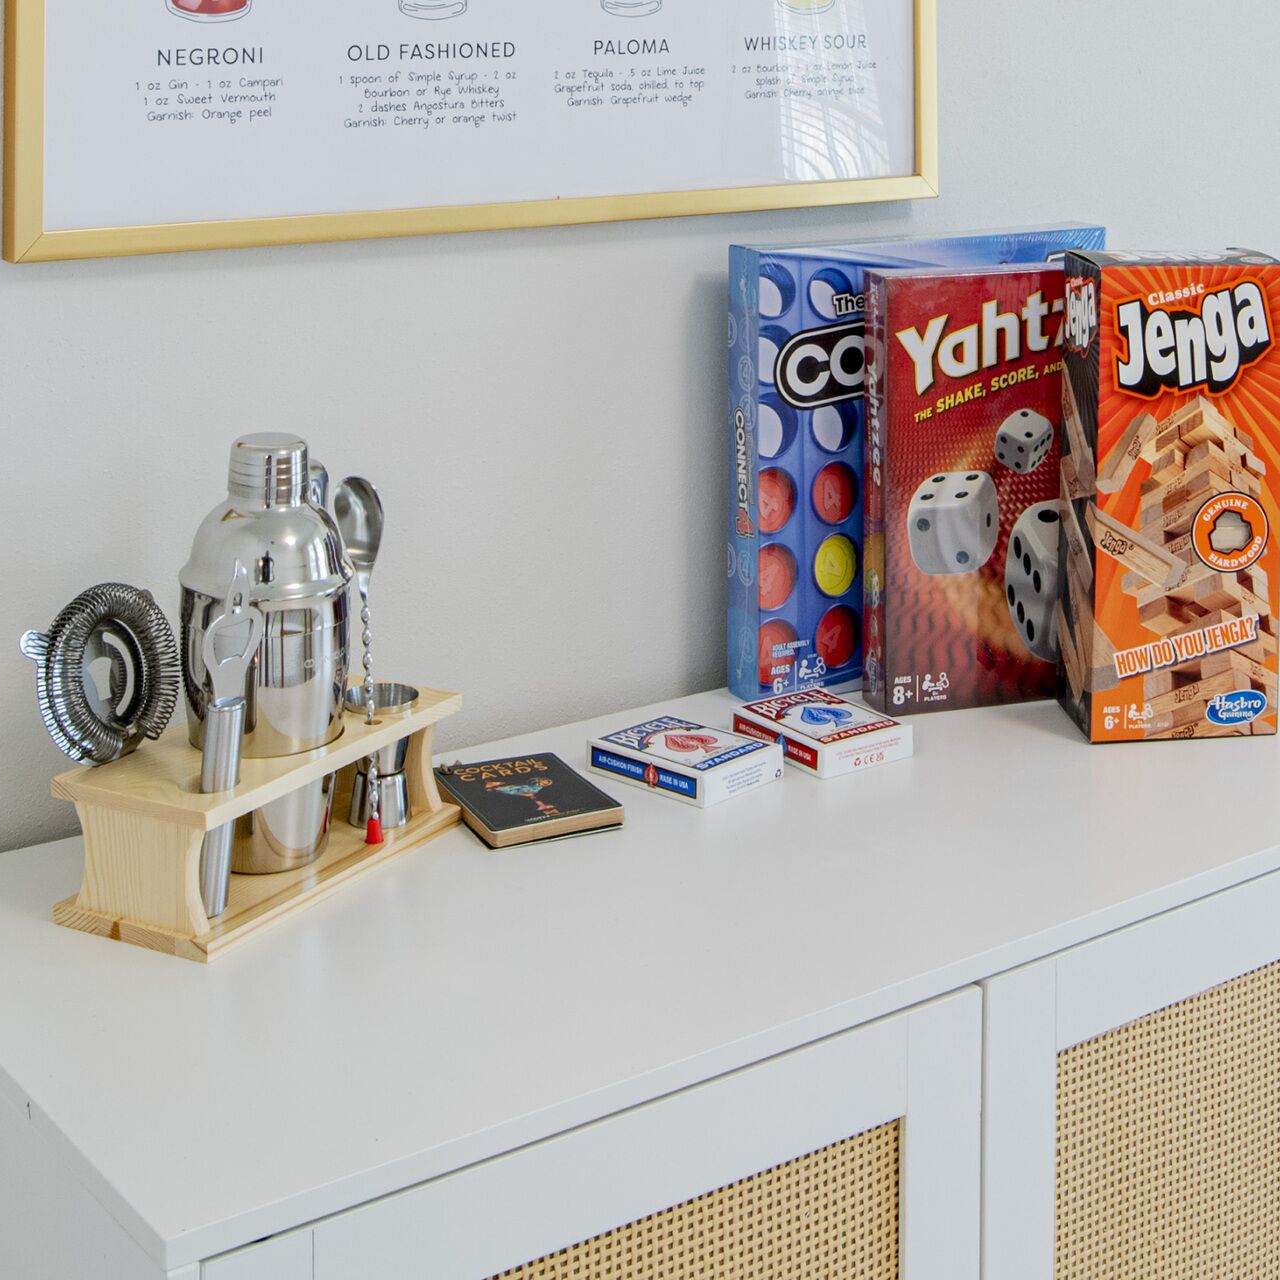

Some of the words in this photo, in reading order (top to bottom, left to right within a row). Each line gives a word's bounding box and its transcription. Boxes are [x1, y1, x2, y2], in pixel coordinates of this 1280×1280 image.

[348, 44, 390, 61] OLD
[400, 42, 515, 60] FASHIONED
[594, 39, 670, 55] PALOMA
[744, 35, 818, 51] WHISKEY
[824, 34, 866, 49] SOUR
[158, 47, 262, 66] NEGRONI
[168, 80, 188, 89] Gin
[239, 77, 283, 91] Campari
[350, 76, 381, 87] spoon
[388, 71, 401, 82] of
[408, 72, 441, 85] Simple
[448, 71, 478, 85] Syrup
[156, 97, 168, 105] oz
[177, 94, 212, 105] Sweet
[221, 92, 276, 103] Vermouth
[364, 88, 409, 98] Bourbon
[416, 88, 427, 96] or
[434, 86, 451, 100] Rye
[458, 85, 500, 97] Whiskey
[611, 93, 659, 107] Grapefruit
[665, 92, 693, 107] wedge
[202, 109, 242, 124] Orange
[250, 107, 272, 122] peel
[371, 101, 406, 112] dashes
[414, 101, 464, 115] Angostura
[471, 99, 504, 108] Bitters
[394, 116, 429, 129] Cherry
[435, 116, 446, 124] or
[452, 114, 485, 128] orange
[492, 112, 517, 121] twist
[834, 294, 864, 314] The
[1148, 283, 1205, 307] Classic
[1066, 282, 1096, 348] Jenga
[1119, 283, 1269, 386] Jenga
[914, 408, 932, 423] THE
[937, 383, 986, 412] SHAKE,
[991, 365, 1039, 391] SCORE,
[1043, 363, 1063, 375] AND
[867, 361, 880, 487] Yahtzee
[735, 407, 748, 515] CONNECT
[1202, 498, 1249, 522] GENUINE
[1100, 531, 1128, 555] Jenga
[1208, 536, 1262, 567] HARDWOOD
[1115, 648, 1149, 675] HOW
[1153, 641, 1172, 666] DO
[1174, 632, 1203, 659] YOU
[1207, 617, 1254, 650] JENGA?
[771, 664, 790, 675] AGES
[773, 678, 789, 694] 6+
[894, 676, 911, 684] AGES
[751, 690, 830, 719] BICYCLE
[893, 686, 913, 705] 8+
[1210, 695, 1261, 709] Hasbro
[1218, 710, 1255, 718] Gaming
[608, 717, 687, 748] BICYCLE
[820, 720, 894, 743] STANDARD
[696, 742, 763, 769] STANDARD
[454, 759, 539, 775] COCKTAIL
[460, 762, 548, 781] CARDS
[627, 762, 642, 774] FINISH
